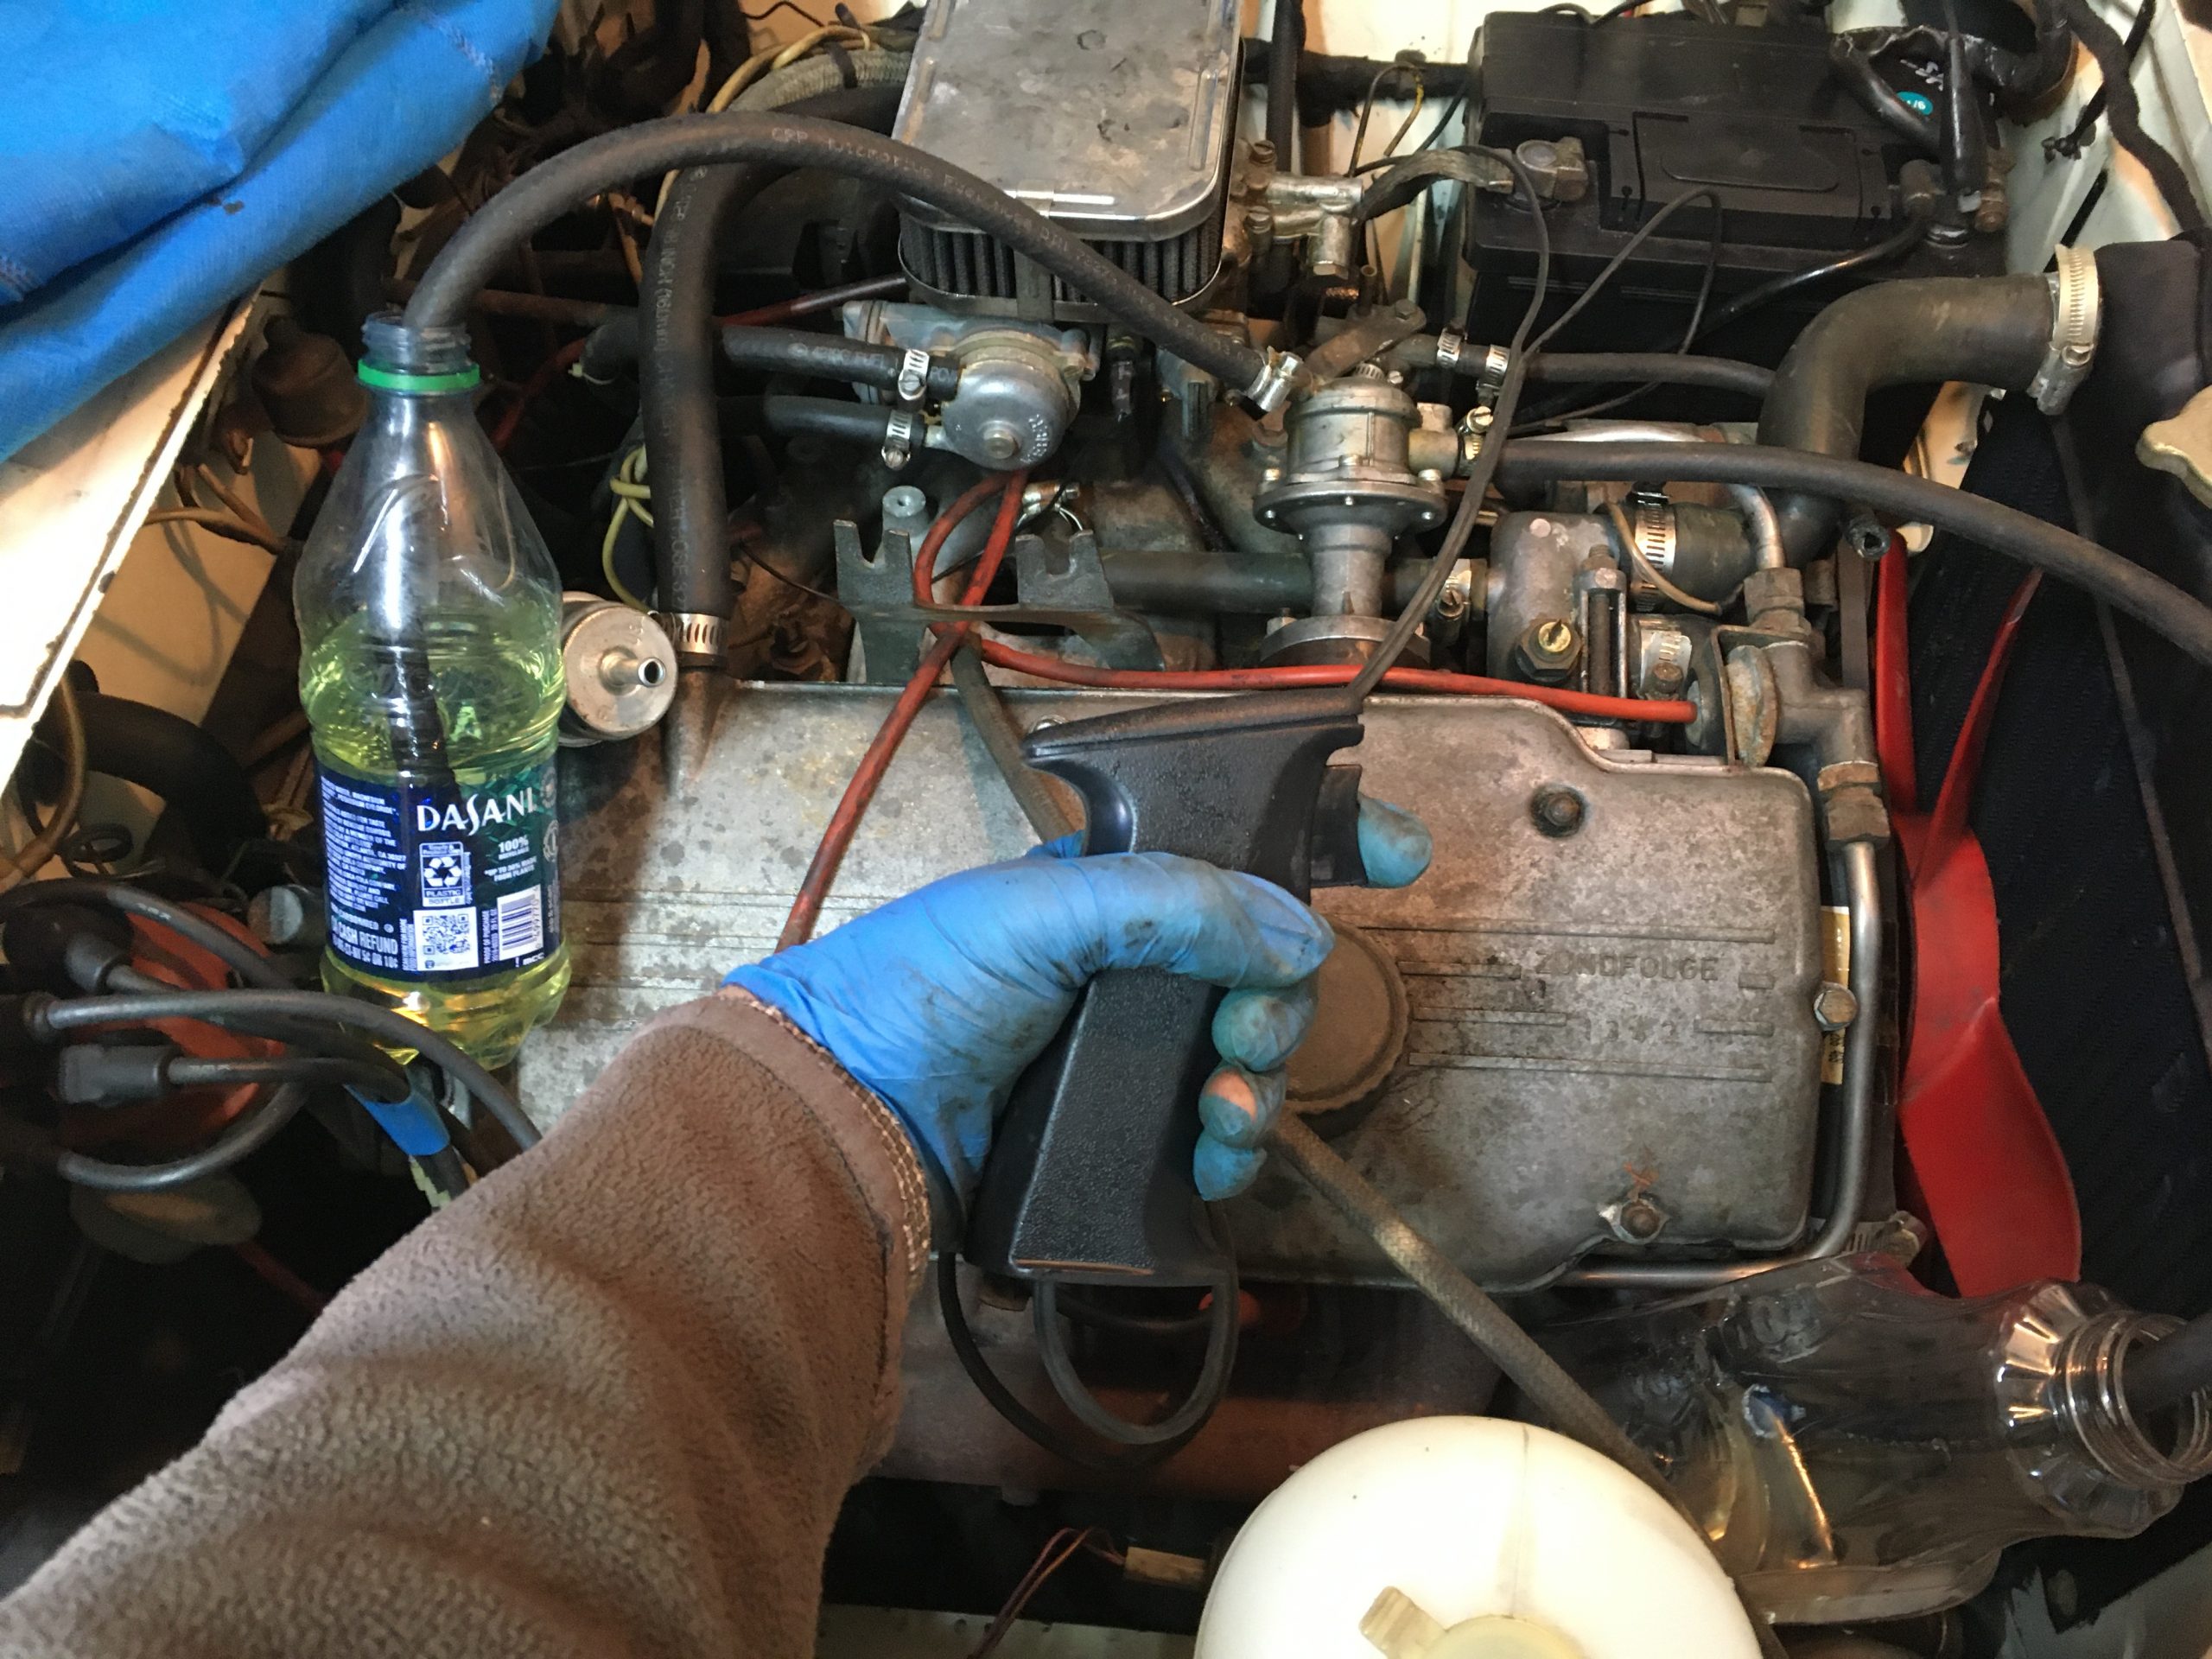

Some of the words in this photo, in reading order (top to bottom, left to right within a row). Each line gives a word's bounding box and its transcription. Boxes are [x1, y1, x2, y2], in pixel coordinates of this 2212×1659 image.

[416, 786, 537, 836] DASANI
[498, 835, 529, 853] 100%
[338, 921, 359, 944] CASH
[359, 931, 398, 955] REFUND
